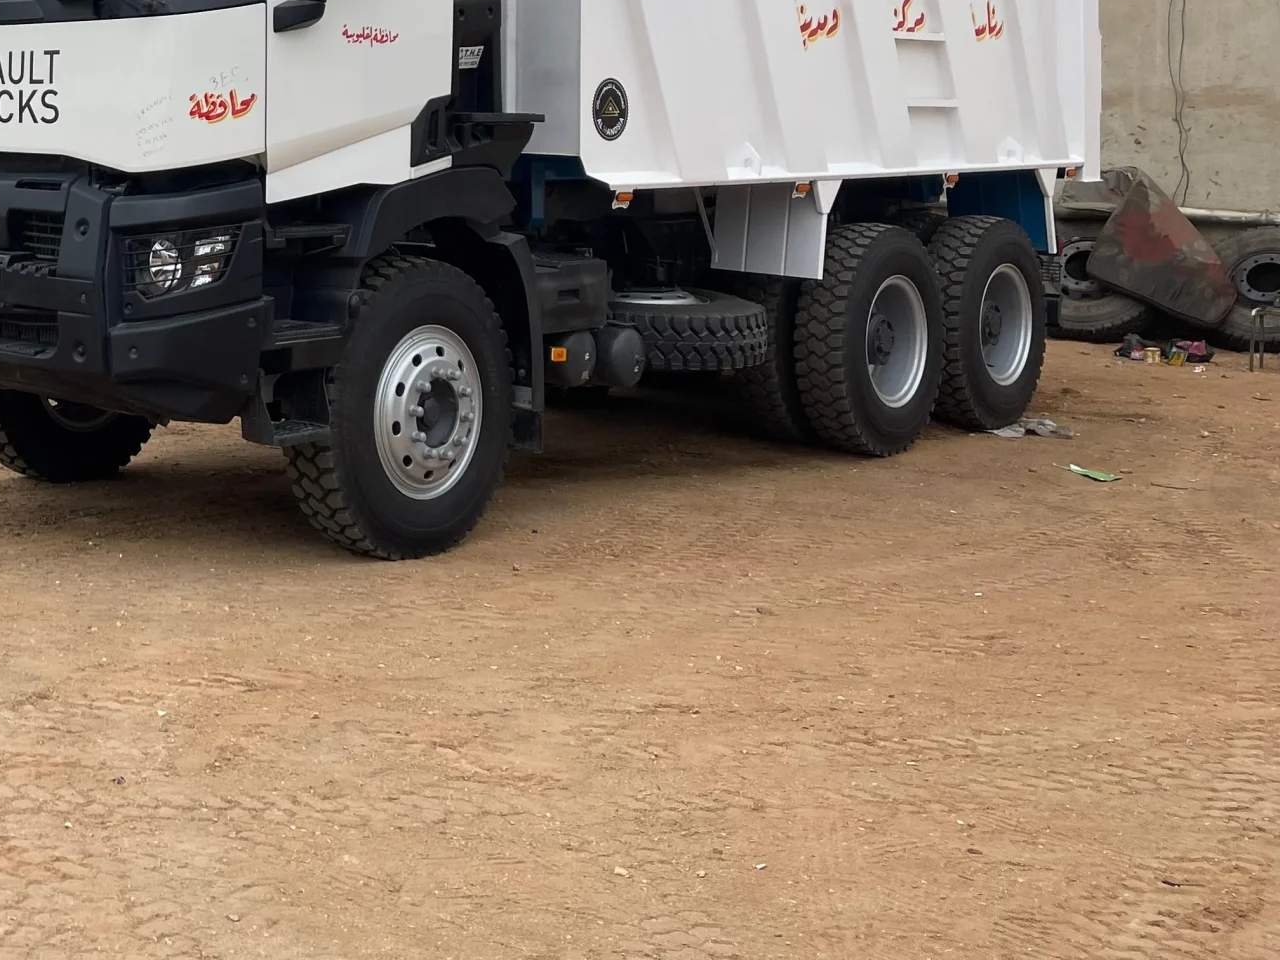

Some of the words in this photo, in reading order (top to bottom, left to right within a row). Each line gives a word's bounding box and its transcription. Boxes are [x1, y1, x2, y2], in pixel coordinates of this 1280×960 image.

[795, 3, 841, 51] ومدين
[970, 0, 1004, 43] رئاس
[188, 88, 257, 124] محافظة
